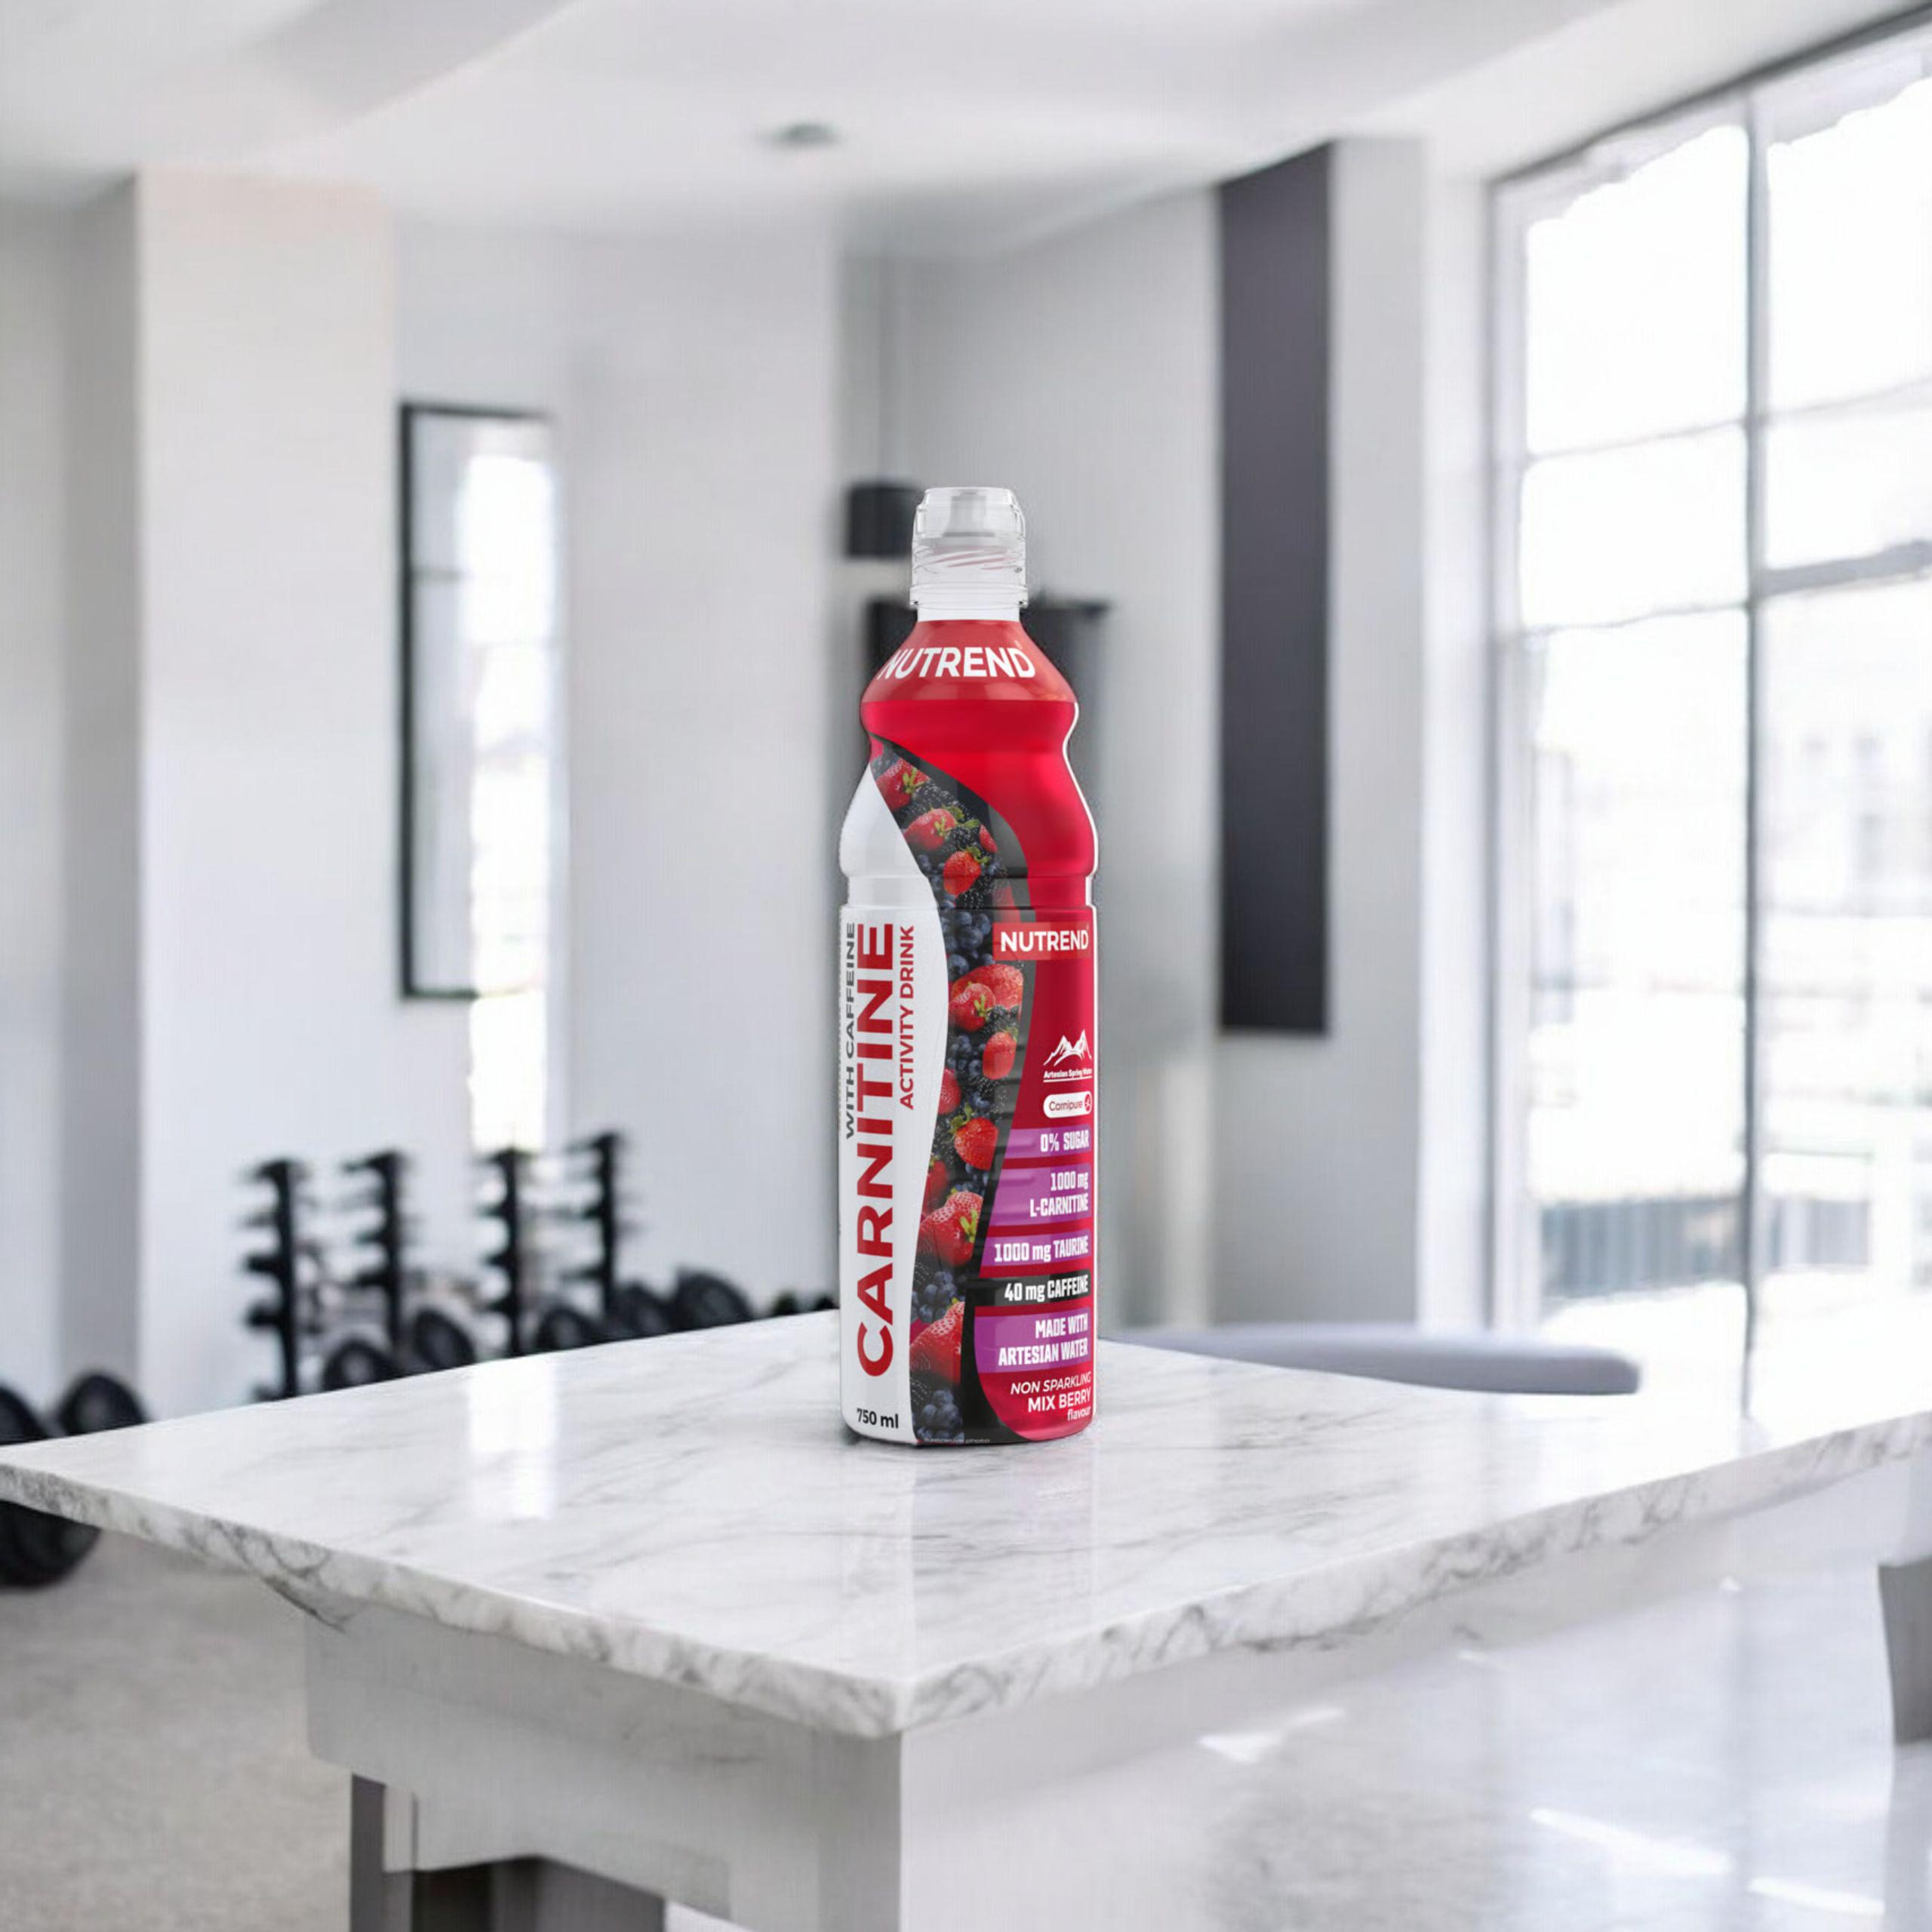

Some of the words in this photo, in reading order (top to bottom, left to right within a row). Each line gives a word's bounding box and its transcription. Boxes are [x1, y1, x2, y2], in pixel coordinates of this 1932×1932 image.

[877, 647, 1036, 679] NUTREND
[1001, 929, 1089, 952] NUTREND
[900, 926, 914, 999] DRINK
[846, 922, 855, 1059] CAFFEINE
[900, 1005, 914, 1110] ACTIVITY
[846, 1066, 854, 1140] WITH
[1049, 1100, 1083, 1112] Carnipure
[857, 924, 894, 1377] CARNITINE
[1041, 1133, 1060, 1152] 0%
[1063, 1130, 1090, 1150] SUGAR
[1051, 1171, 1076, 1191] 1000
[1078, 1172, 1088, 1190] mg
[1030, 1193, 1088, 1217] L-CARNITINE
[995, 1243, 1029, 1263] 1000
[1032, 1244, 1051, 1263] mg
[1053, 1235, 1088, 1259] TAURINE
[1004, 1282, 1023, 1301] 40
[1026, 1284, 1045, 1303] mg
[1048, 1274, 1088, 1299] CAFFEINE
[1035, 1317, 1066, 1339] MADE
[1068, 1312, 1088, 1334] WITH
[998, 1343, 1059, 1366] ARTESIAN
[1061, 1337, 1088, 1360] WATER
[1011, 1380, 1040, 1395] NON
[1043, 1371, 1092, 1392] SPARKLING
[1028, 1395, 1056, 1413] MIX
[1059, 1387, 1091, 1409] BERRY
[1067, 1406, 1091, 1421] flavour
[857, 1408, 878, 1426] 750
[880, 1414, 899, 1429] ml
